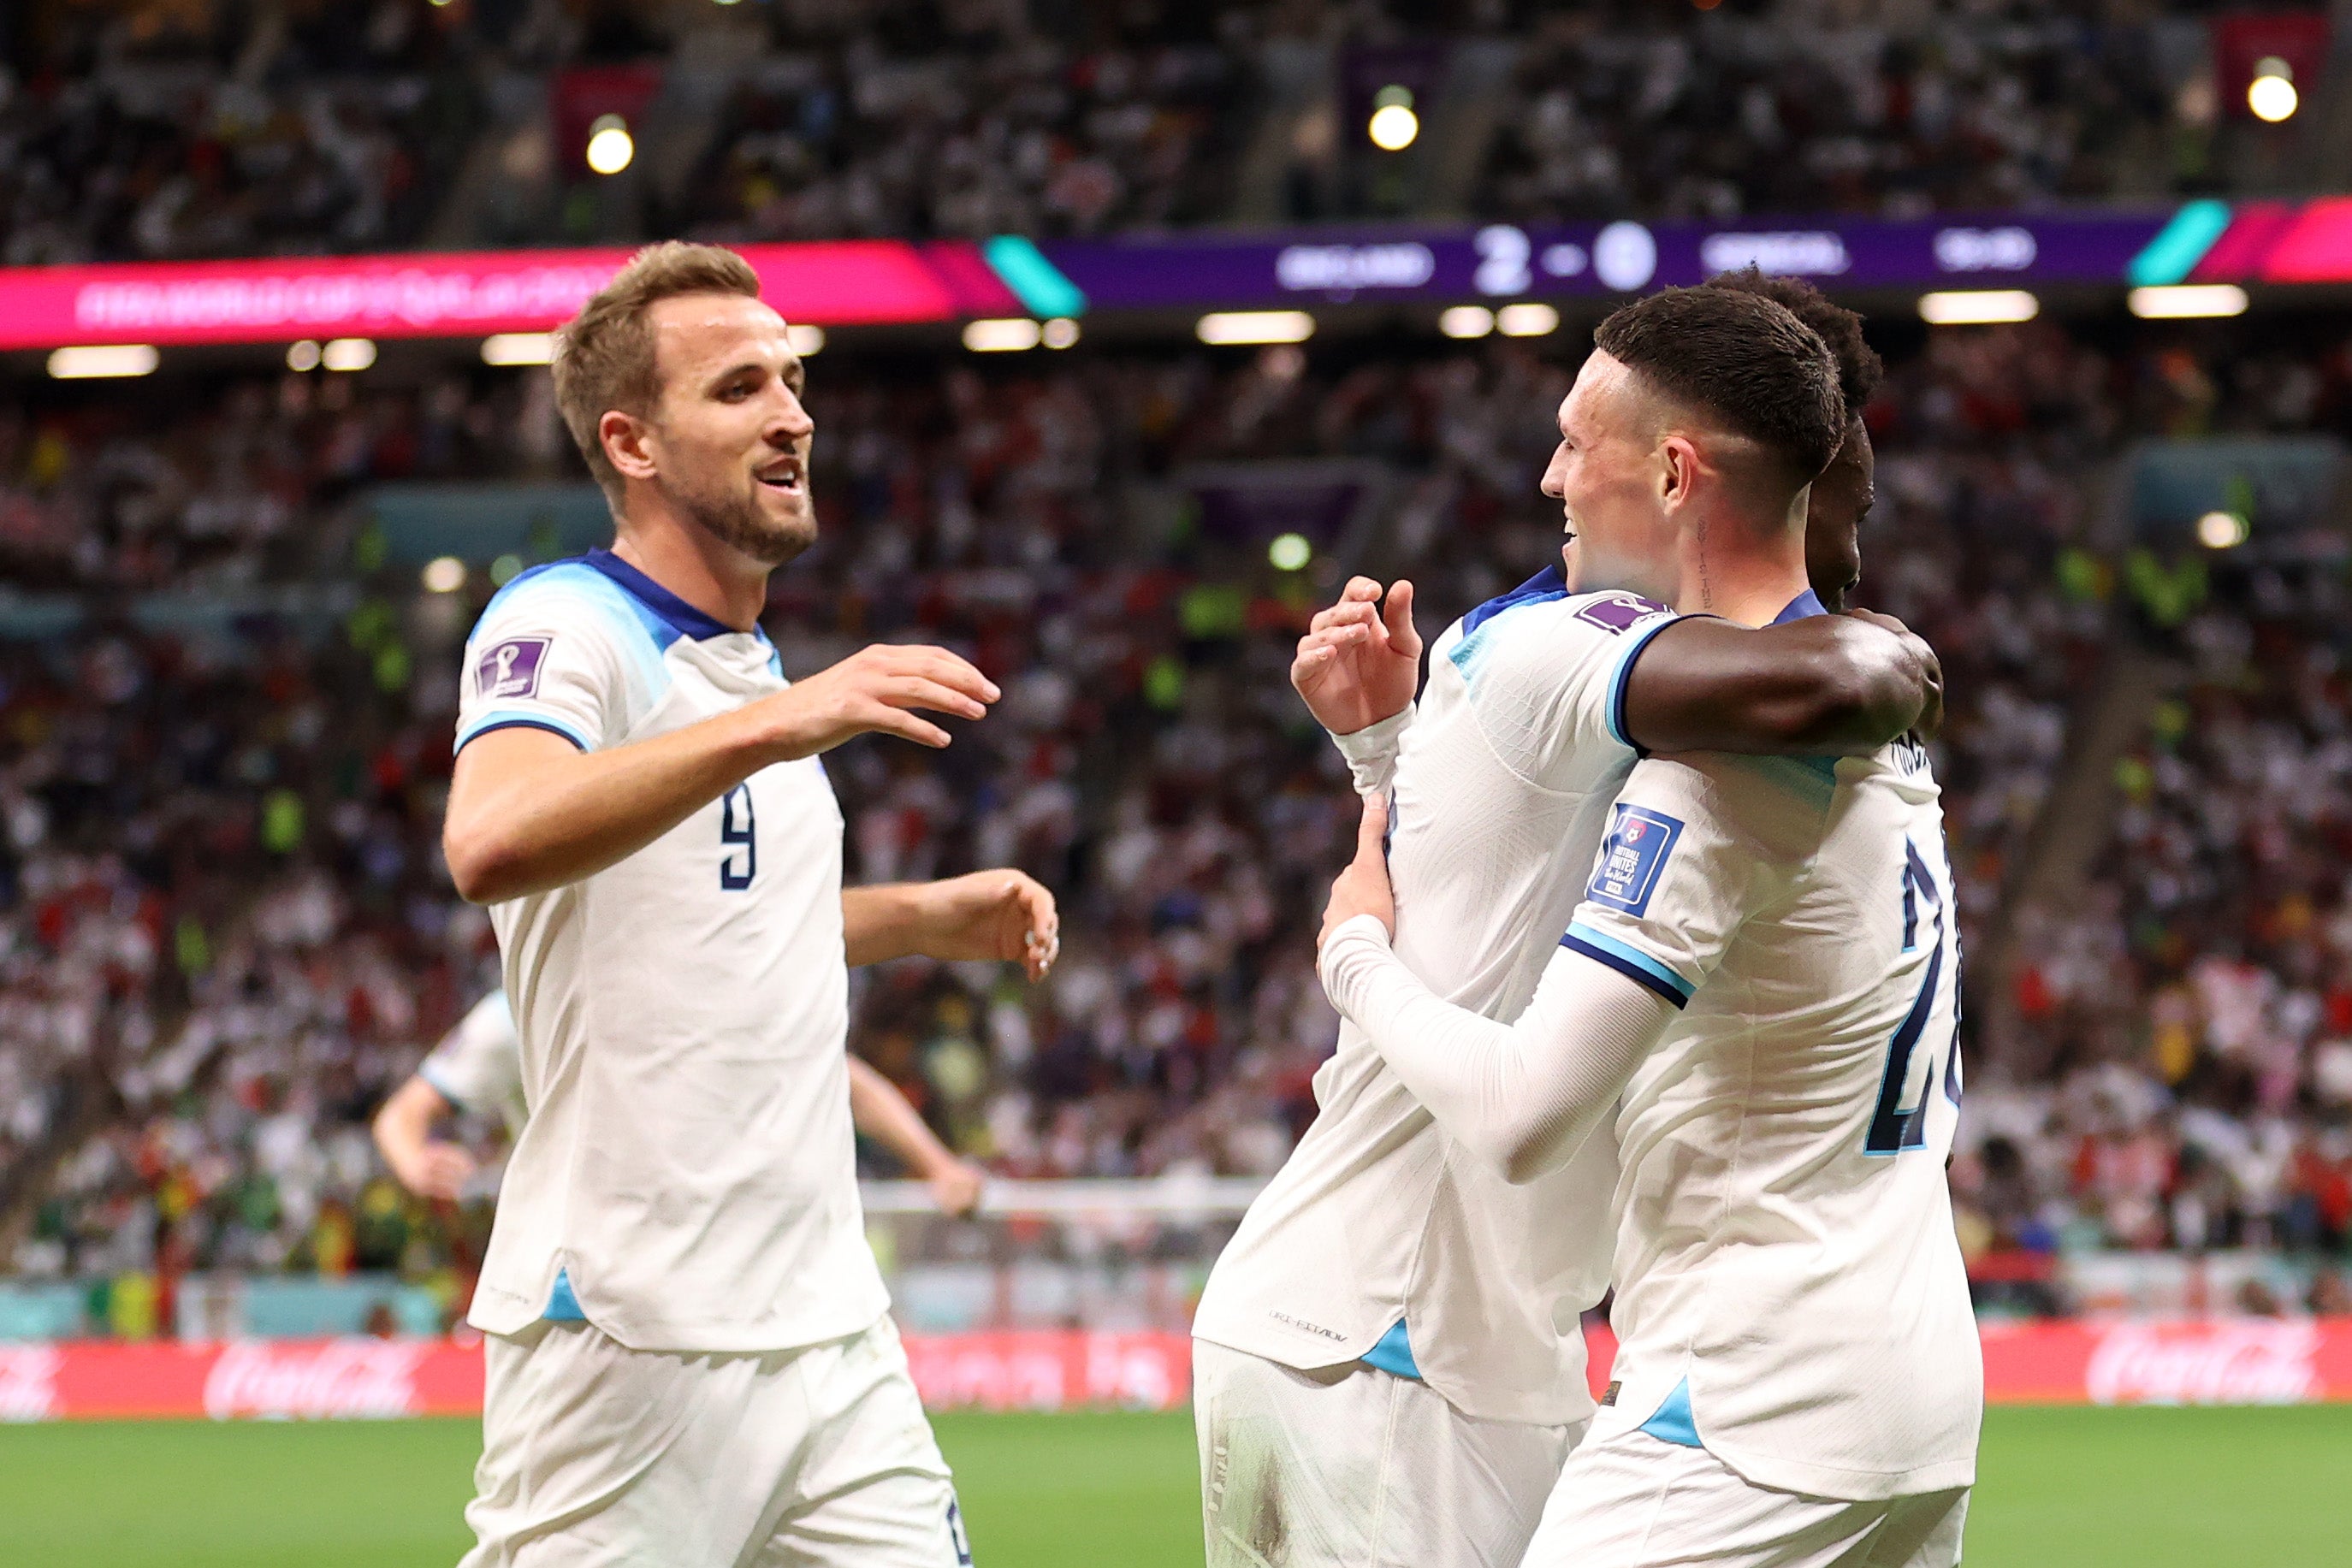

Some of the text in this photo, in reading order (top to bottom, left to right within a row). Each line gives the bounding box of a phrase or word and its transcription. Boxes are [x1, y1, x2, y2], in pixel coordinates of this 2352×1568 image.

[1474, 224, 1532, 296] 2
[1593, 220, 1657, 292] 0
[720, 782, 756, 891] 9
[1609, 854, 1638, 873] UNITES
[1863, 821, 1964, 1157] 2
